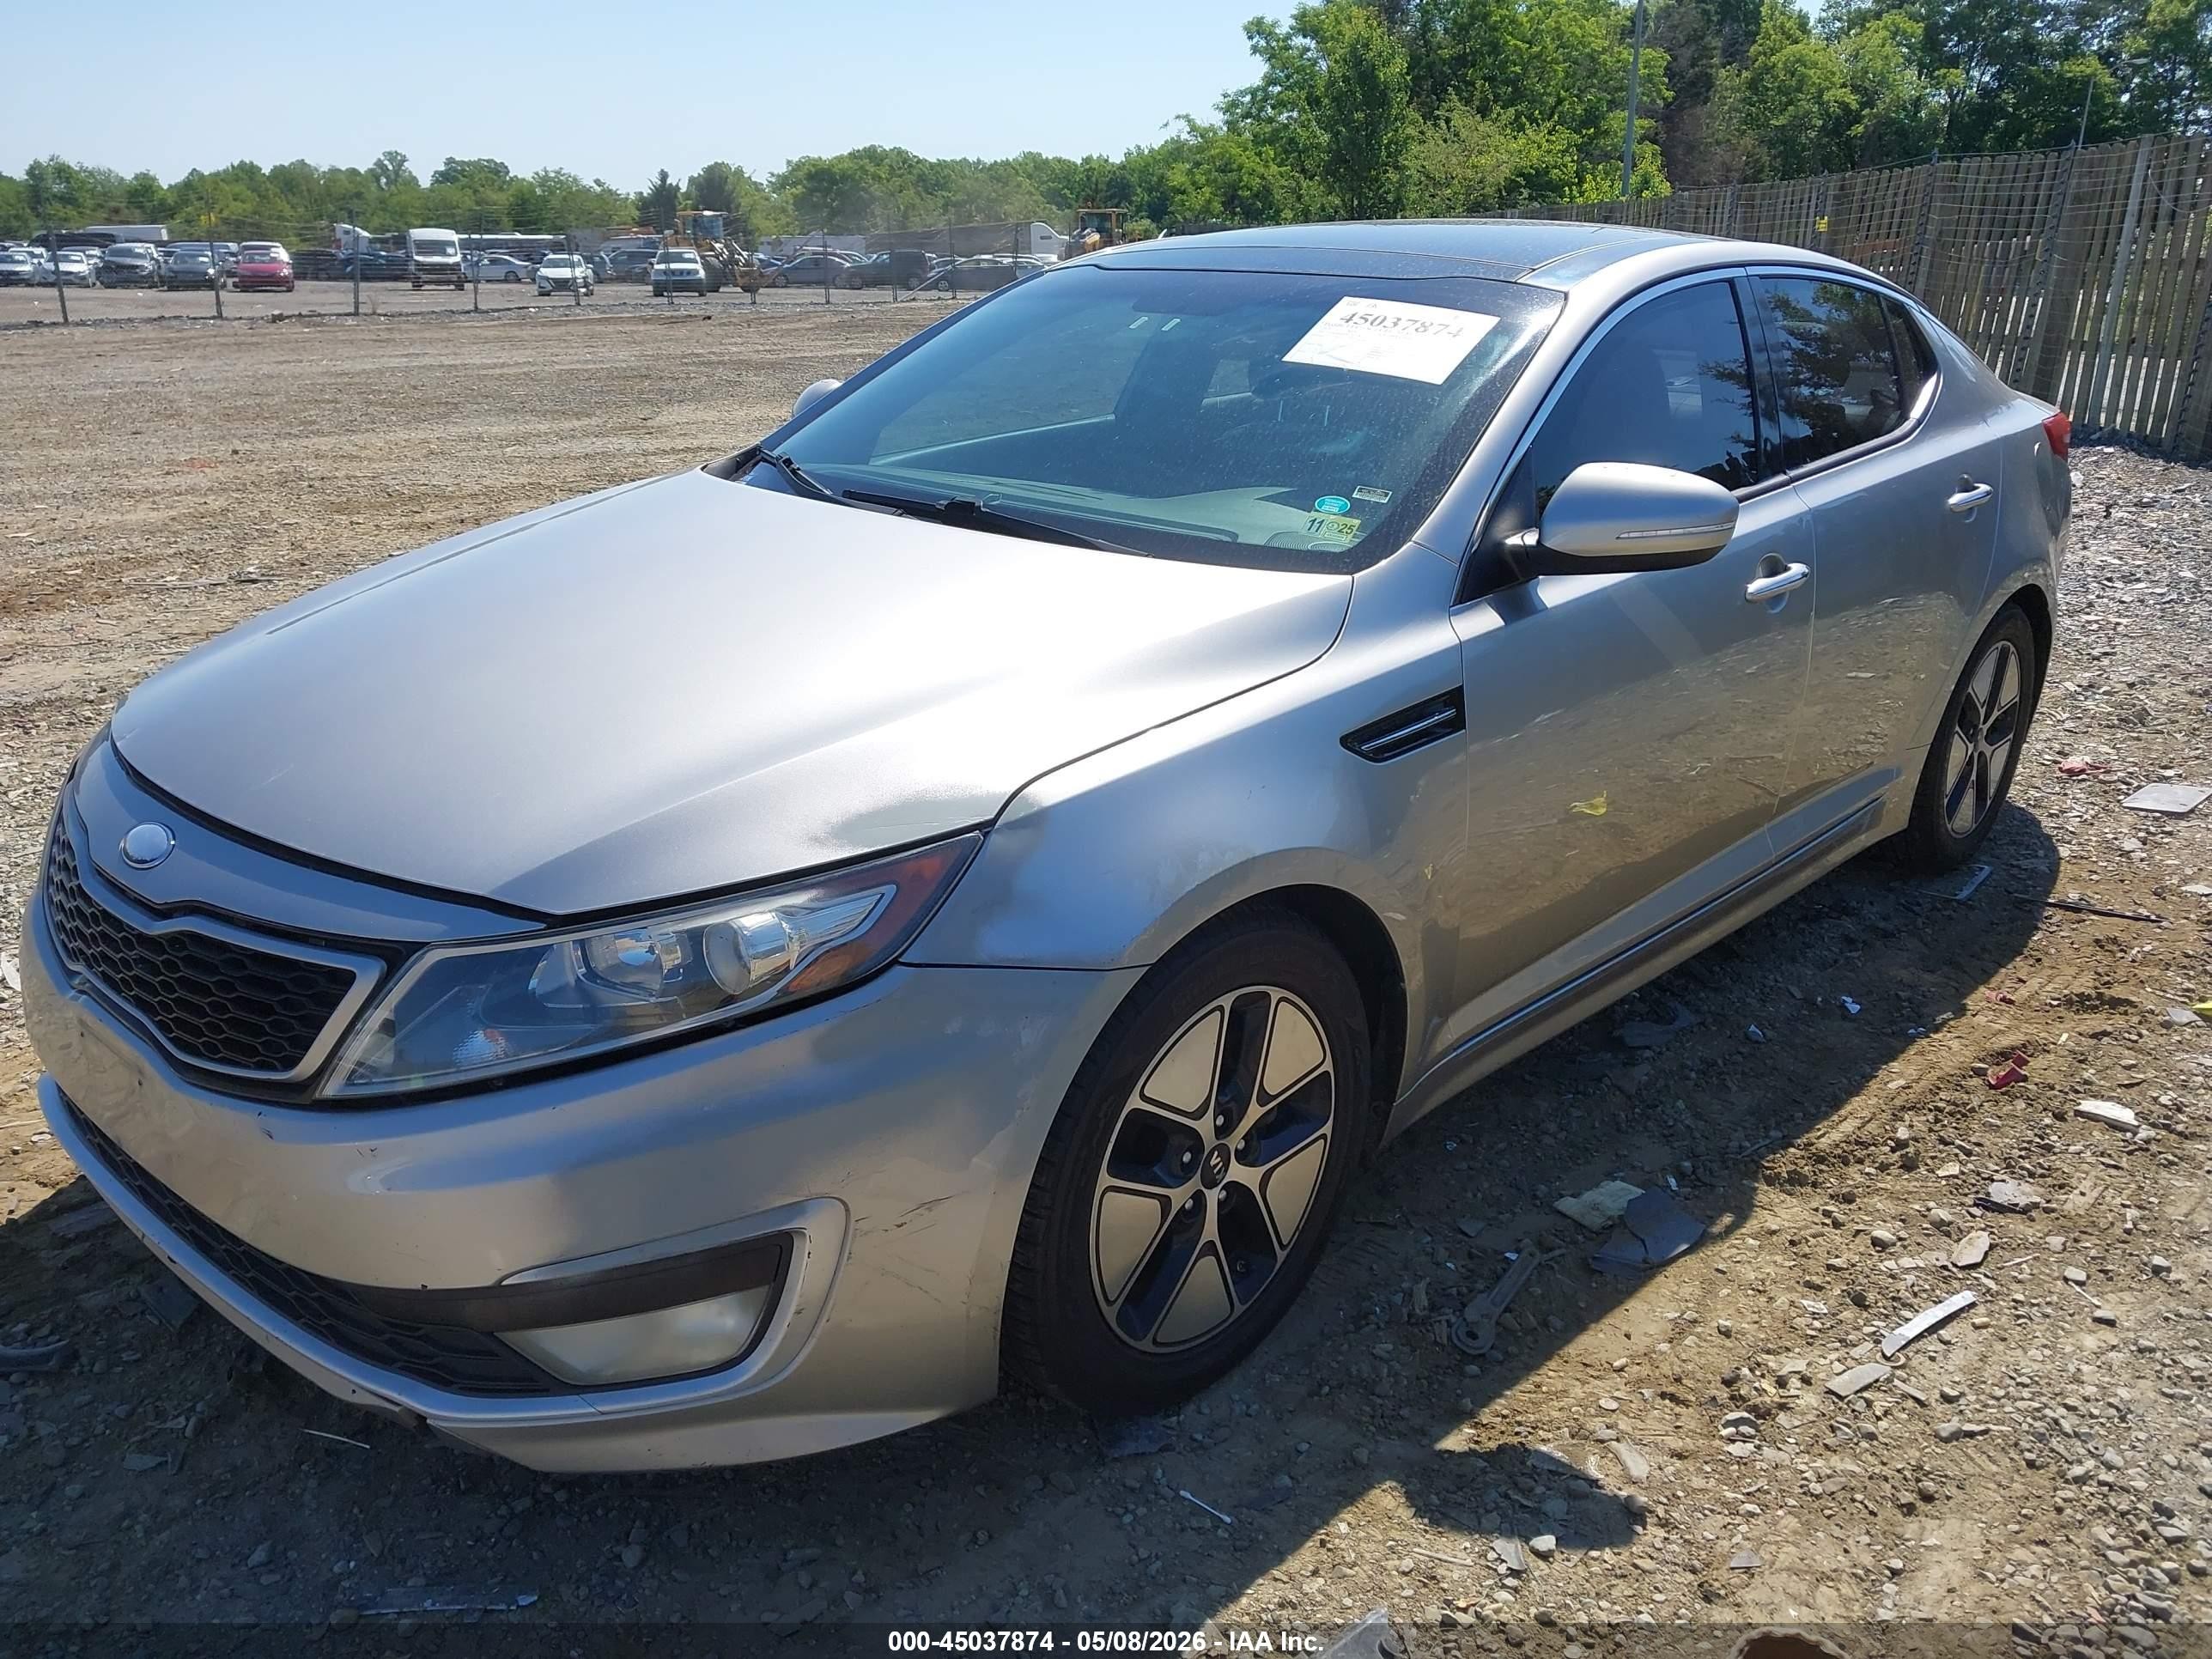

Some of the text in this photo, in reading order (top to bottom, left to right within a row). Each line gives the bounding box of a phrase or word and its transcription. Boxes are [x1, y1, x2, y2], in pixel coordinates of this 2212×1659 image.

[1340, 311, 1464, 338] 45037874
[1308, 518, 1356, 535] 11 25
